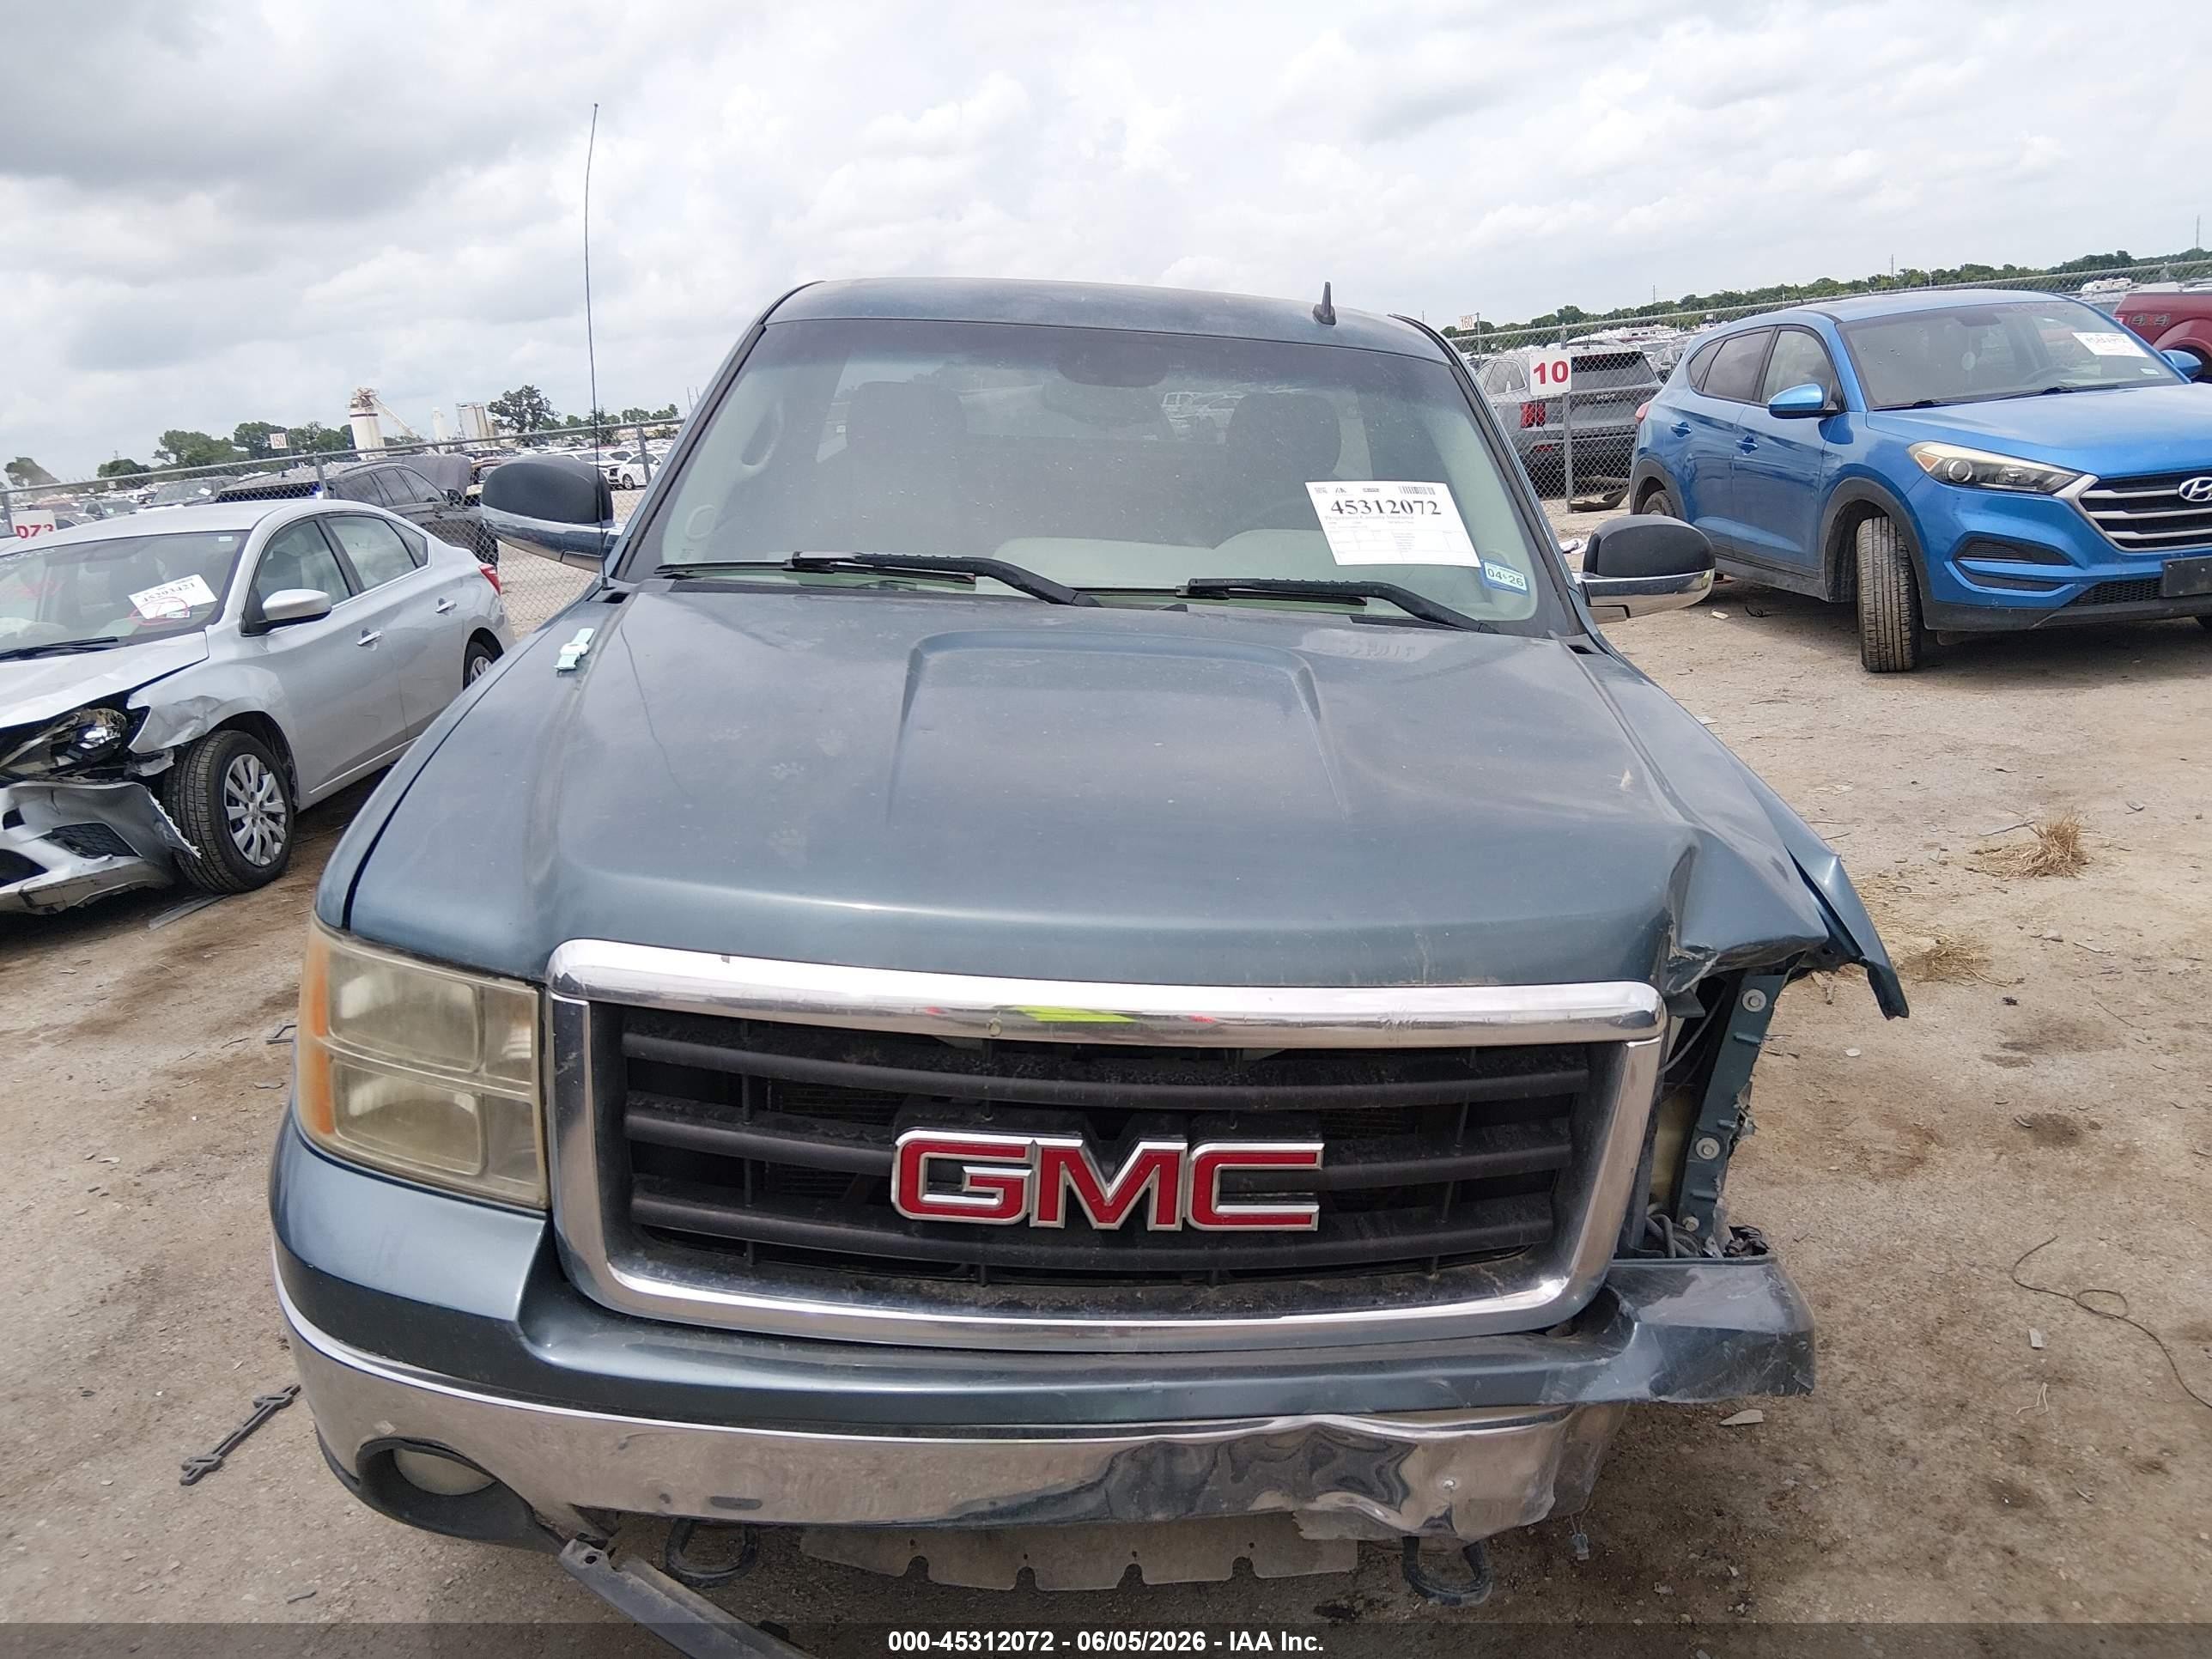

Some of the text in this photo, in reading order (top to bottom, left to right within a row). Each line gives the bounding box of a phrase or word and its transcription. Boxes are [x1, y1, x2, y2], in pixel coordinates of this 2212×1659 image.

[1533, 361, 1569, 385] 10
[1331, 500, 1442, 515] 45312072
[890, 1127, 1326, 1232] GMC
